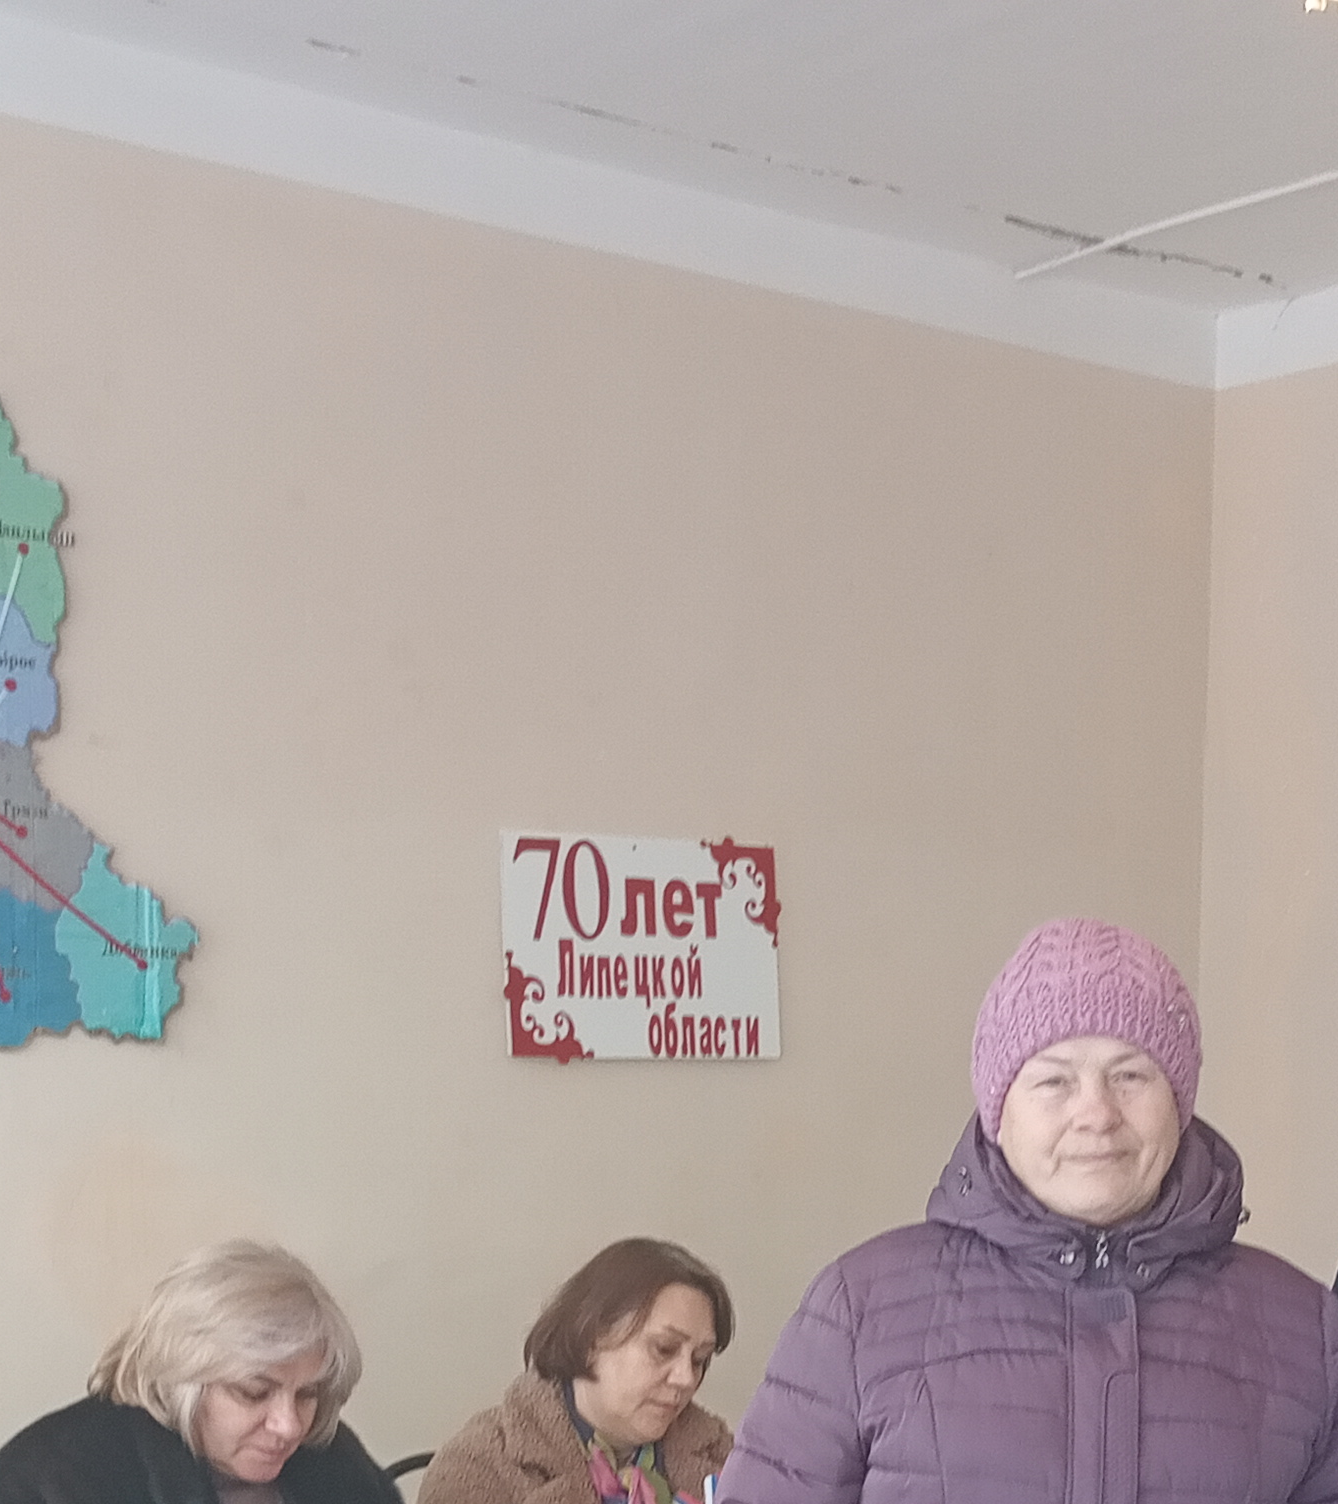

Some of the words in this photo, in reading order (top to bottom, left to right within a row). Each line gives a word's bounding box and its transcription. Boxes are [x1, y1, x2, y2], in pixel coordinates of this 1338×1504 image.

[512, 836, 610, 942] 70
[619, 875, 722, 940] лет
[557, 937, 703, 1009] Липецкой
[648, 1000, 759, 1058] области
